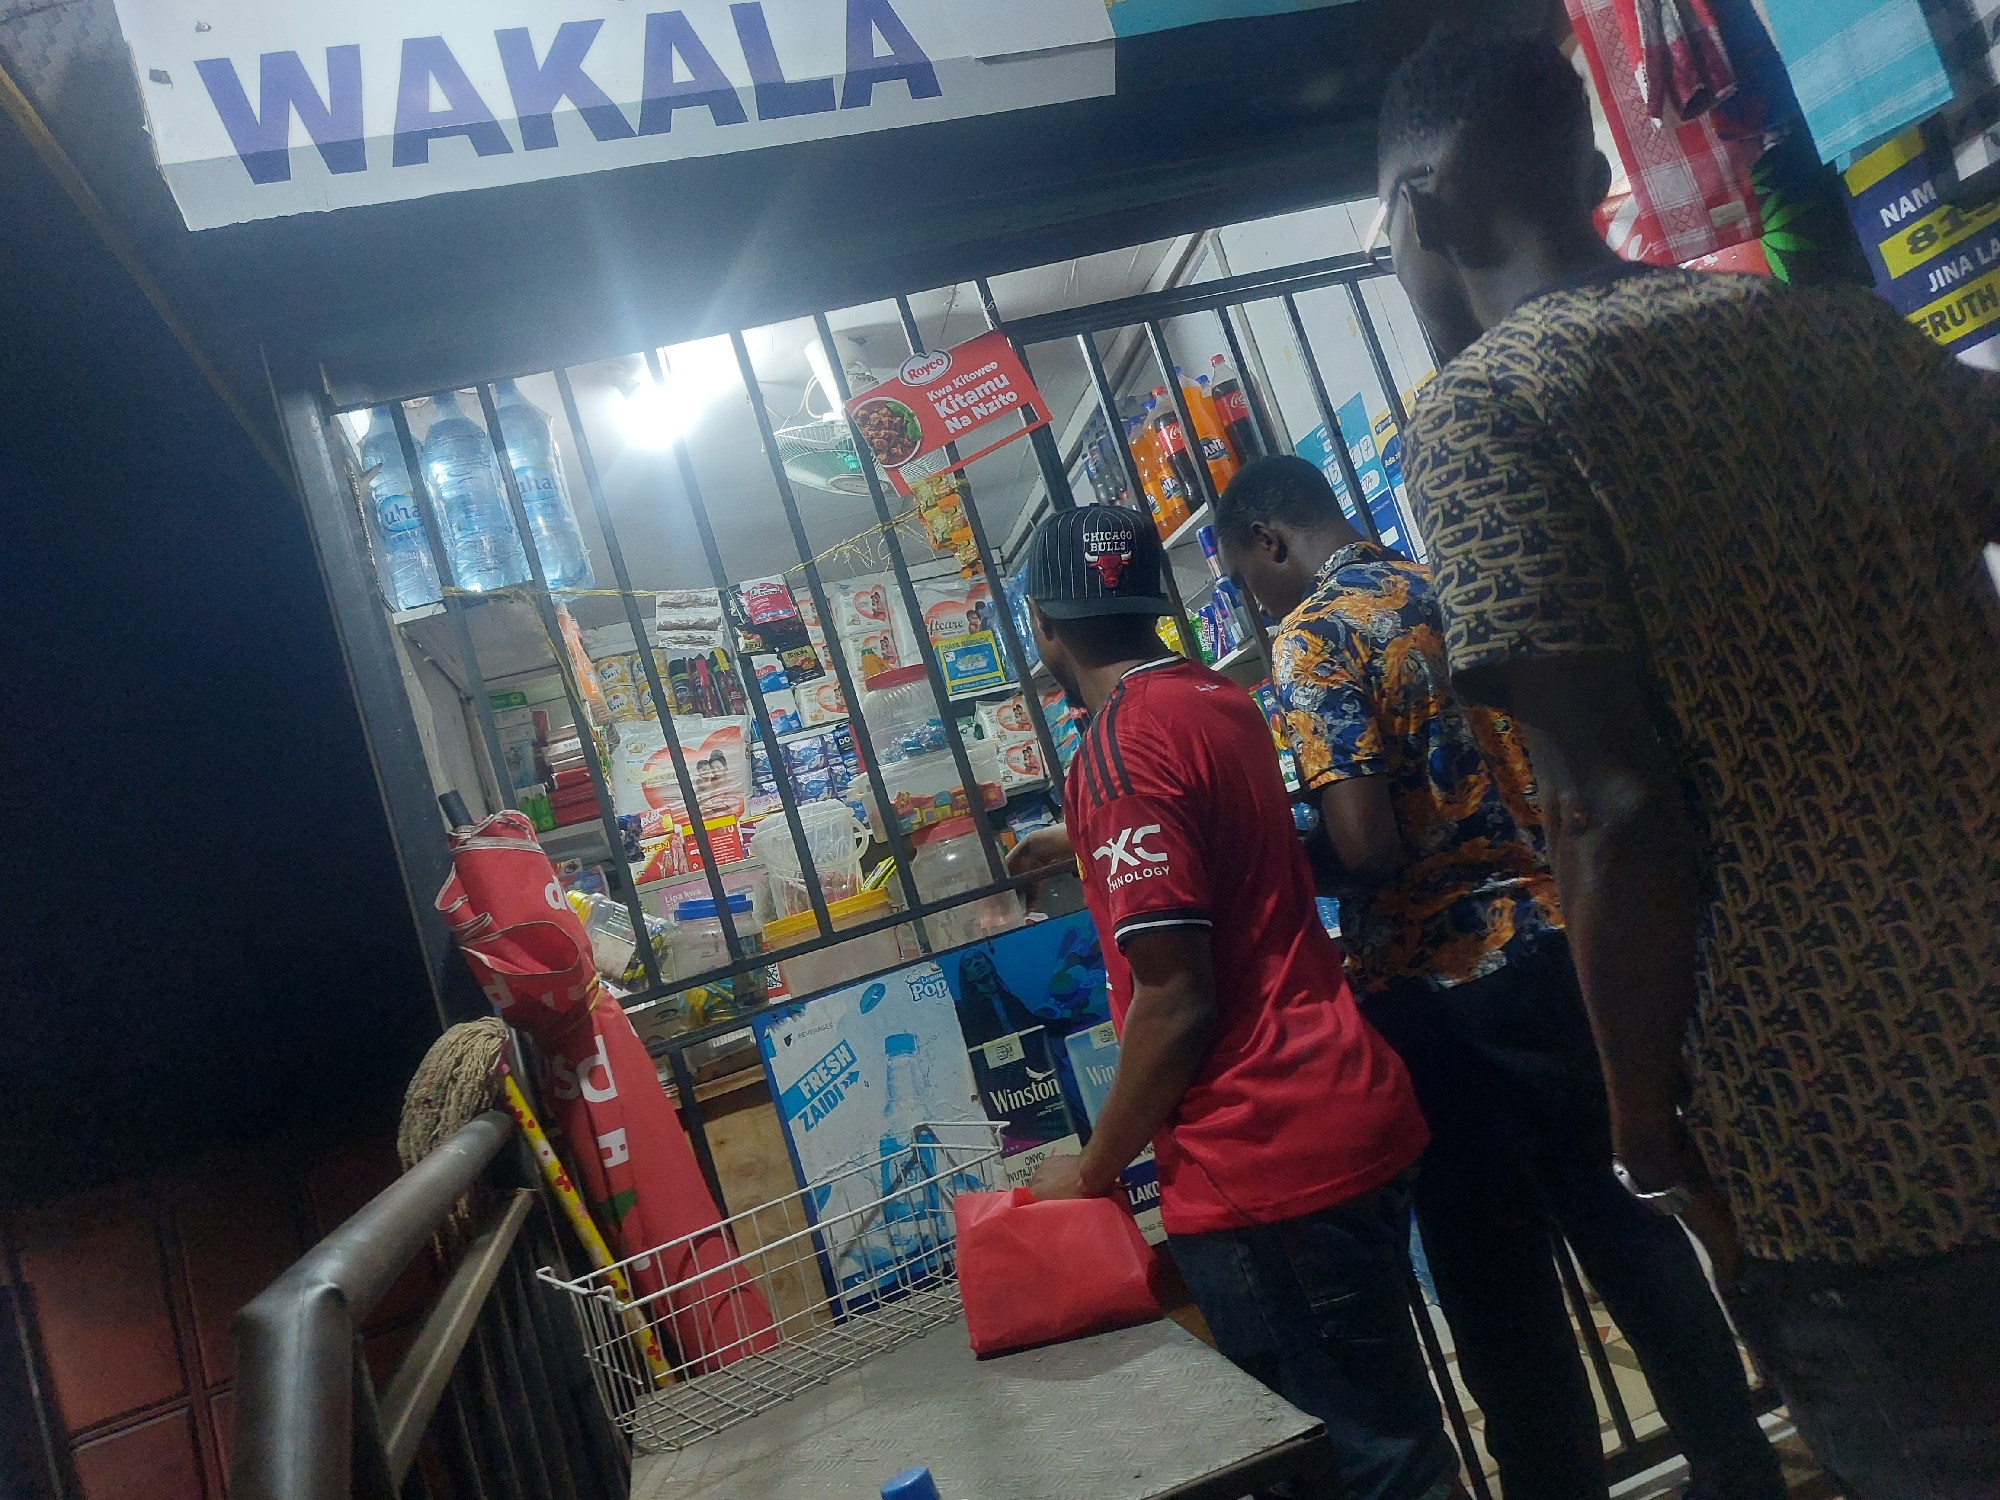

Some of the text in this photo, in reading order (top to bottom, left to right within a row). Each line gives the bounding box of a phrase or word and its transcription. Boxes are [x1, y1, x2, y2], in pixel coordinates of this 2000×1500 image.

[194, 0, 942, 187] WAKALA
[1880, 180, 1937, 228] NAM
[1906, 201, 1997, 255] 81
[1929, 255, 1973, 292] JINA
[906, 356, 945, 381] Royco
[926, 361, 998, 402] Kwa Kitoweo
[933, 373, 1011, 419] Kitamu
[944, 390, 1018, 434] Na Nzito
[1083, 531, 1132, 543] CHICAGO
[1090, 541, 1126, 552] BULLS
[664, 892, 683, 903] Lipa
[683, 889, 701, 898] kwa
[798, 1044, 853, 1100] FRESH
[798, 1083, 845, 1132] ZAIDI
[989, 1078, 1061, 1114] Winston
